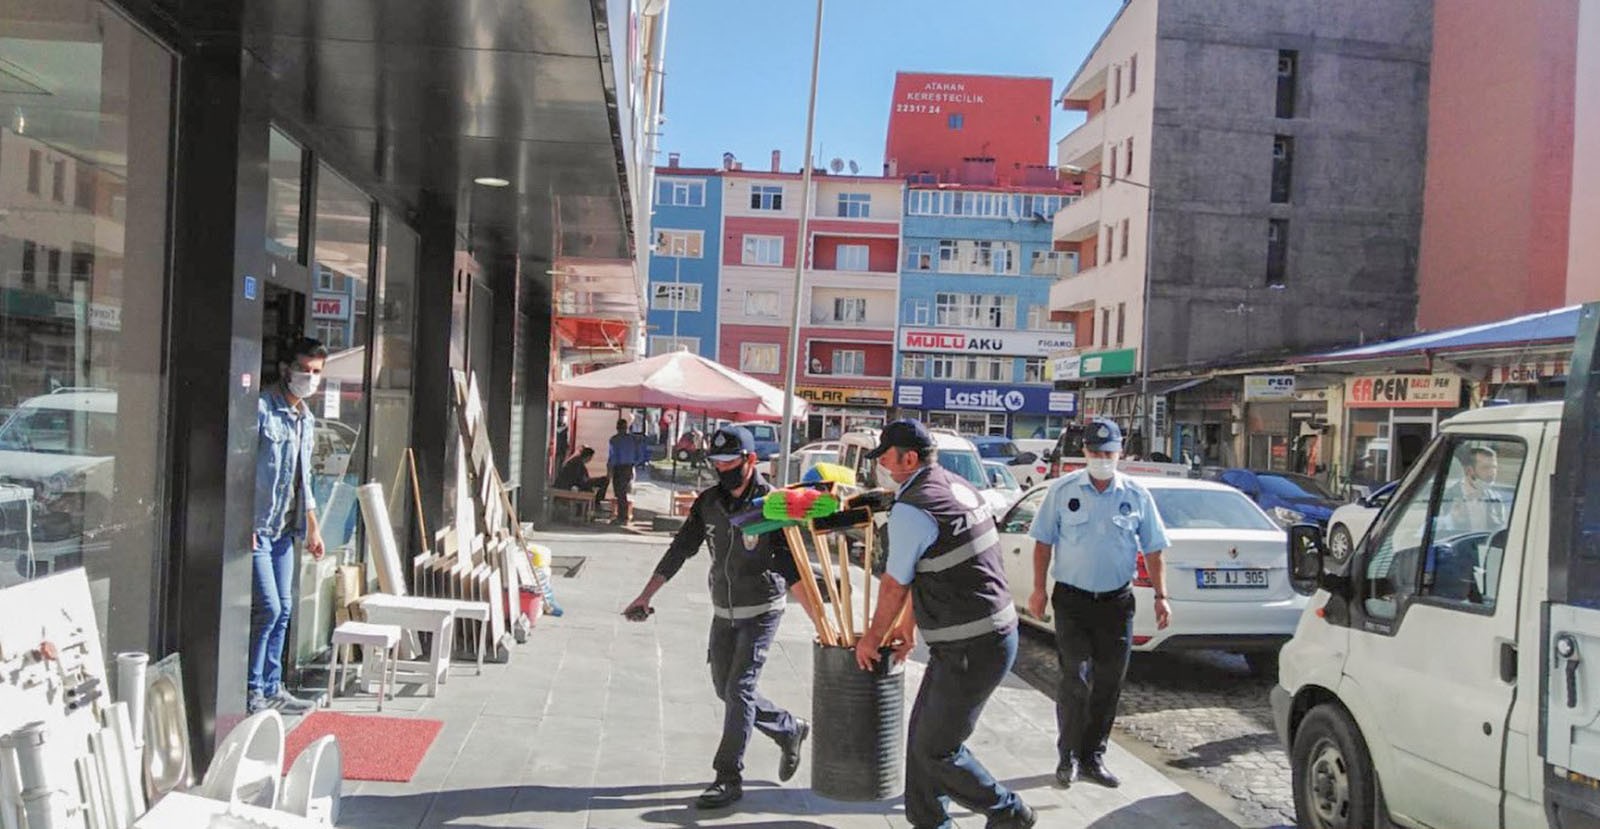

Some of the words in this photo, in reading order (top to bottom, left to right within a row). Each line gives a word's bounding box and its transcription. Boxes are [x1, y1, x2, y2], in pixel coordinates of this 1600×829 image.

[906, 331, 966, 349] MUTLU
[944, 388, 1005, 408] Lastik
[1203, 571, 1217, 584] 36
[1225, 571, 1239, 584] AJ
[1244, 571, 1265, 584] 905
